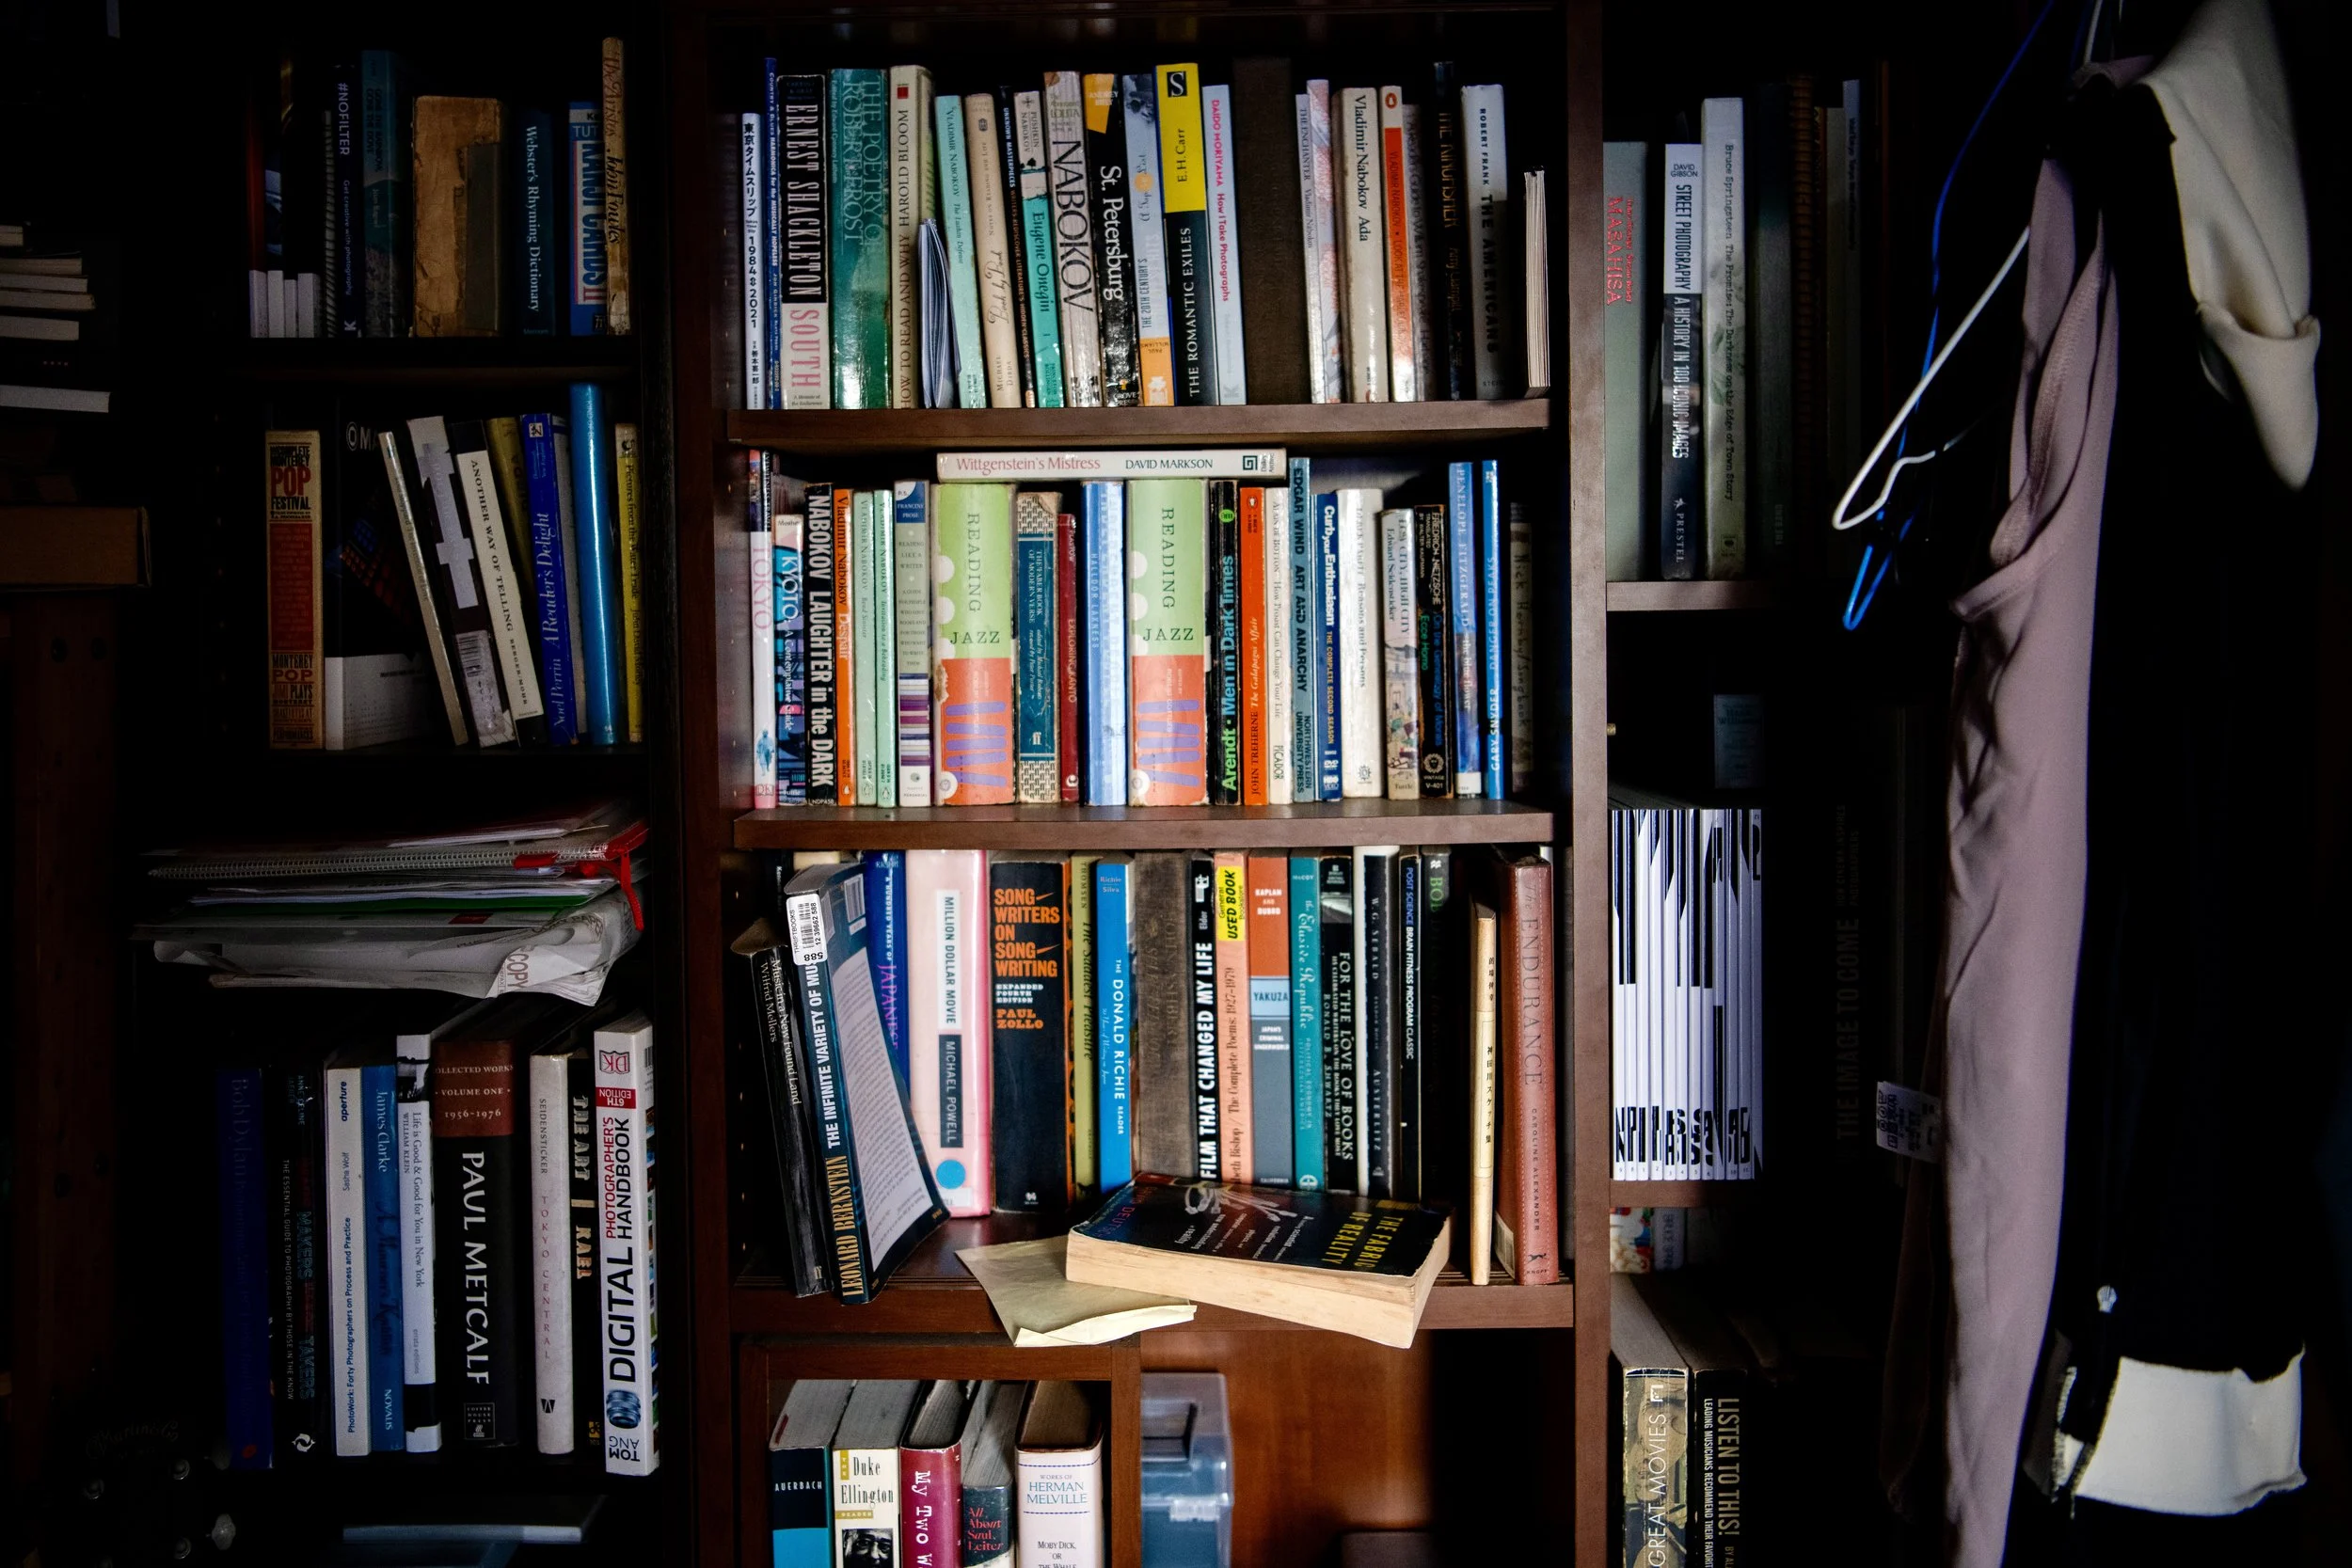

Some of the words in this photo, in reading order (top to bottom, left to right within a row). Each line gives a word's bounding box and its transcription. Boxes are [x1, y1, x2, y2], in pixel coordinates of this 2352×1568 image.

[338, 83, 349, 155] #NOFILTER
[863, 74, 882, 126] THE
[1212, 100, 1221, 130] DAIDO
[786, 104, 820, 171] ERNEST
[842, 82, 862, 166] ROBERT
[898, 109, 910, 161] BLOOM
[1176, 129, 1186, 154] Carr
[1354, 96, 1369, 151] Vladimir
[1480, 108, 1488, 148] ROBERT
[525, 126, 538, 182] Webster's
[1214, 134, 1224, 186] MORIYAMA
[1481, 152, 1489, 186] FRANK
[863, 132, 882, 220] POETRY
[1100, 166, 1121, 191] St.
[1356, 154, 1370, 209] Nabokov
[526, 186, 539, 243] Rhyming
[844, 169, 863, 245] FROST
[898, 166, 910, 226] HAROLD
[1216, 194, 1226, 214] How
[1481, 195, 1494, 229] THE
[1676, 184, 1691, 218] STREET
[787, 182, 821, 295] SHACKLETON
[1032, 213, 1048, 259] Eugene
[1053, 141, 1093, 312] NABOKOV
[1218, 221, 1228, 242] Take
[1359, 217, 1371, 242] Ada
[898, 235, 910, 267] WHY
[1104, 198, 1125, 301] Petersburg
[1181, 228, 1192, 277] EXILES
[1675, 222, 1692, 289] PHOTOGRAPHY
[529, 246, 541, 311] Dictionary
[899, 273, 911, 304] AND
[1035, 264, 1051, 312] Onegin
[1218, 244, 1231, 302] Photographs
[1483, 239, 1500, 353] AMERICANS
[900, 309, 911, 345] READ
[1184, 282, 1198, 361] ROMANTIC
[1674, 308, 1690, 347] HISTORY
[790, 309, 821, 388] SOUTH
[901, 350, 911, 371] TO
[1674, 351, 1689, 361] IN
[1189, 367, 1200, 397] THE
[1673, 363, 1689, 382] 100
[901, 377, 911, 409] HOW
[1671, 386, 1690, 418] ICONIC
[1671, 420, 1690, 459] IMAGES
[957, 458, 1044, 470] Wittgenstein's
[1048, 459, 1101, 469] Mistress
[1124, 459, 1158, 470] DAVID
[1159, 459, 1214, 470] MARKSON
[471, 461, 491, 521] ANOTHER
[1294, 468, 1305, 514] EDGAR
[484, 525, 497, 551] WAY
[808, 496, 831, 579] NABOKOV
[1295, 519, 1305, 555] WIND
[1675, 513, 1684, 562] PRESTEL
[490, 555, 501, 572] OF
[968, 513, 981, 612] READING
[1162, 508, 1175, 609] READING
[782, 556, 799, 623] KYOTO:
[1223, 556, 1235, 603] Times
[1295, 566, 1305, 591] ART
[494, 576, 514, 632] TELLING
[1295, 596, 1305, 623] AND
[809, 592, 832, 682] LAUGHTER
[950, 632, 1000, 644] JAZZ
[1143, 628, 1194, 641] JAZZ
[1223, 612, 1236, 650] Dark
[784, 639, 794, 702] Contemplative
[1224, 659, 1235, 670] in
[1296, 627, 1308, 691] ANARCHY
[811, 688, 831, 702] in
[1223, 688, 1236, 715] Men
[785, 705, 794, 730] Guide
[812, 707, 832, 735] the
[1296, 711, 1305, 763] UNIVERSITY
[812, 739, 834, 786] DARK
[1224, 729, 1237, 791] Arendt
[1304, 715, 1312, 789] NORTHWESTERN
[1296, 766, 1305, 793] PRESS
[1224, 870, 1237, 904] BOOK
[945, 896, 955, 941] MILLION
[993, 907, 1060, 924] WRITERS
[993, 924, 1015, 941] ON
[1225, 908, 1238, 939] USED
[945, 945, 956, 986] DOLLAR
[993, 960, 1057, 977] WRITING
[1195, 943, 1211, 976] LIFE
[1340, 952, 1351, 982] FOR
[808, 990, 822, 1006] OF
[946, 990, 956, 1024] MOVIE
[1112, 980, 1124, 1043] DONALD
[1196, 980, 1212, 1004] MY
[1340, 990, 1352, 1024] THE
[812, 1010, 831, 1063] VARIETY
[1197, 1011, 1214, 1089] CHANGED
[1341, 1035, 1353, 1073] LOVE
[946, 1041, 956, 1092] MICHAEL
[1114, 1051, 1125, 1099] RICHIE
[376, 1088, 390, 1130] James
[597, 1088, 632, 1098] EDITION
[819, 1066, 837, 1119] INFINITE
[1342, 1078, 1353, 1101] OF
[946, 1097, 958, 1143] POWELL
[1200, 1096, 1215, 1135] THAT
[1342, 1105, 1354, 1160] BOOKS
[377, 1132, 390, 1172] Clarke
[824, 1127, 840, 1148] THE
[604, 1118, 616, 1239] PHOTOGRAPHER'S
[615, 1117, 632, 1240] HANDBOOK
[1200, 1141, 1216, 1179] FILM
[462, 1151, 486, 1229] PAUL
[825, 1157, 856, 1230] BERNSTEIN
[1349, 1212, 1373, 1223] OF
[1375, 1215, 1405, 1233] THE
[1321, 1223, 1365, 1264] REALITY
[1353, 1233, 1393, 1268] FABRIC
[834, 1232, 864, 1296] LEONARD
[464, 1242, 491, 1385] METCALF
[608, 1246, 635, 1382] DIGITAL
[608, 1438, 641, 1448] ANG
[1718, 1399, 1740, 1459] LISTEN
[609, 1449, 641, 1462] TOM
[852, 1455, 881, 1475] Duke
[1648, 1414, 1666, 1495] MOVIES
[1718, 1462, 1740, 1484] TO
[773, 1481, 822, 1492] AUERBACH
[840, 1485, 894, 1509] Ellington
[913, 1470, 931, 1497] My
[1027, 1493, 1088, 1504] MELVILLE
[1029, 1481, 1084, 1494] HERMAN
[917, 1505, 932, 1544] Two
[1718, 1490, 1740, 1536] THIS!
[1647, 1503, 1666, 1567] GREAT
